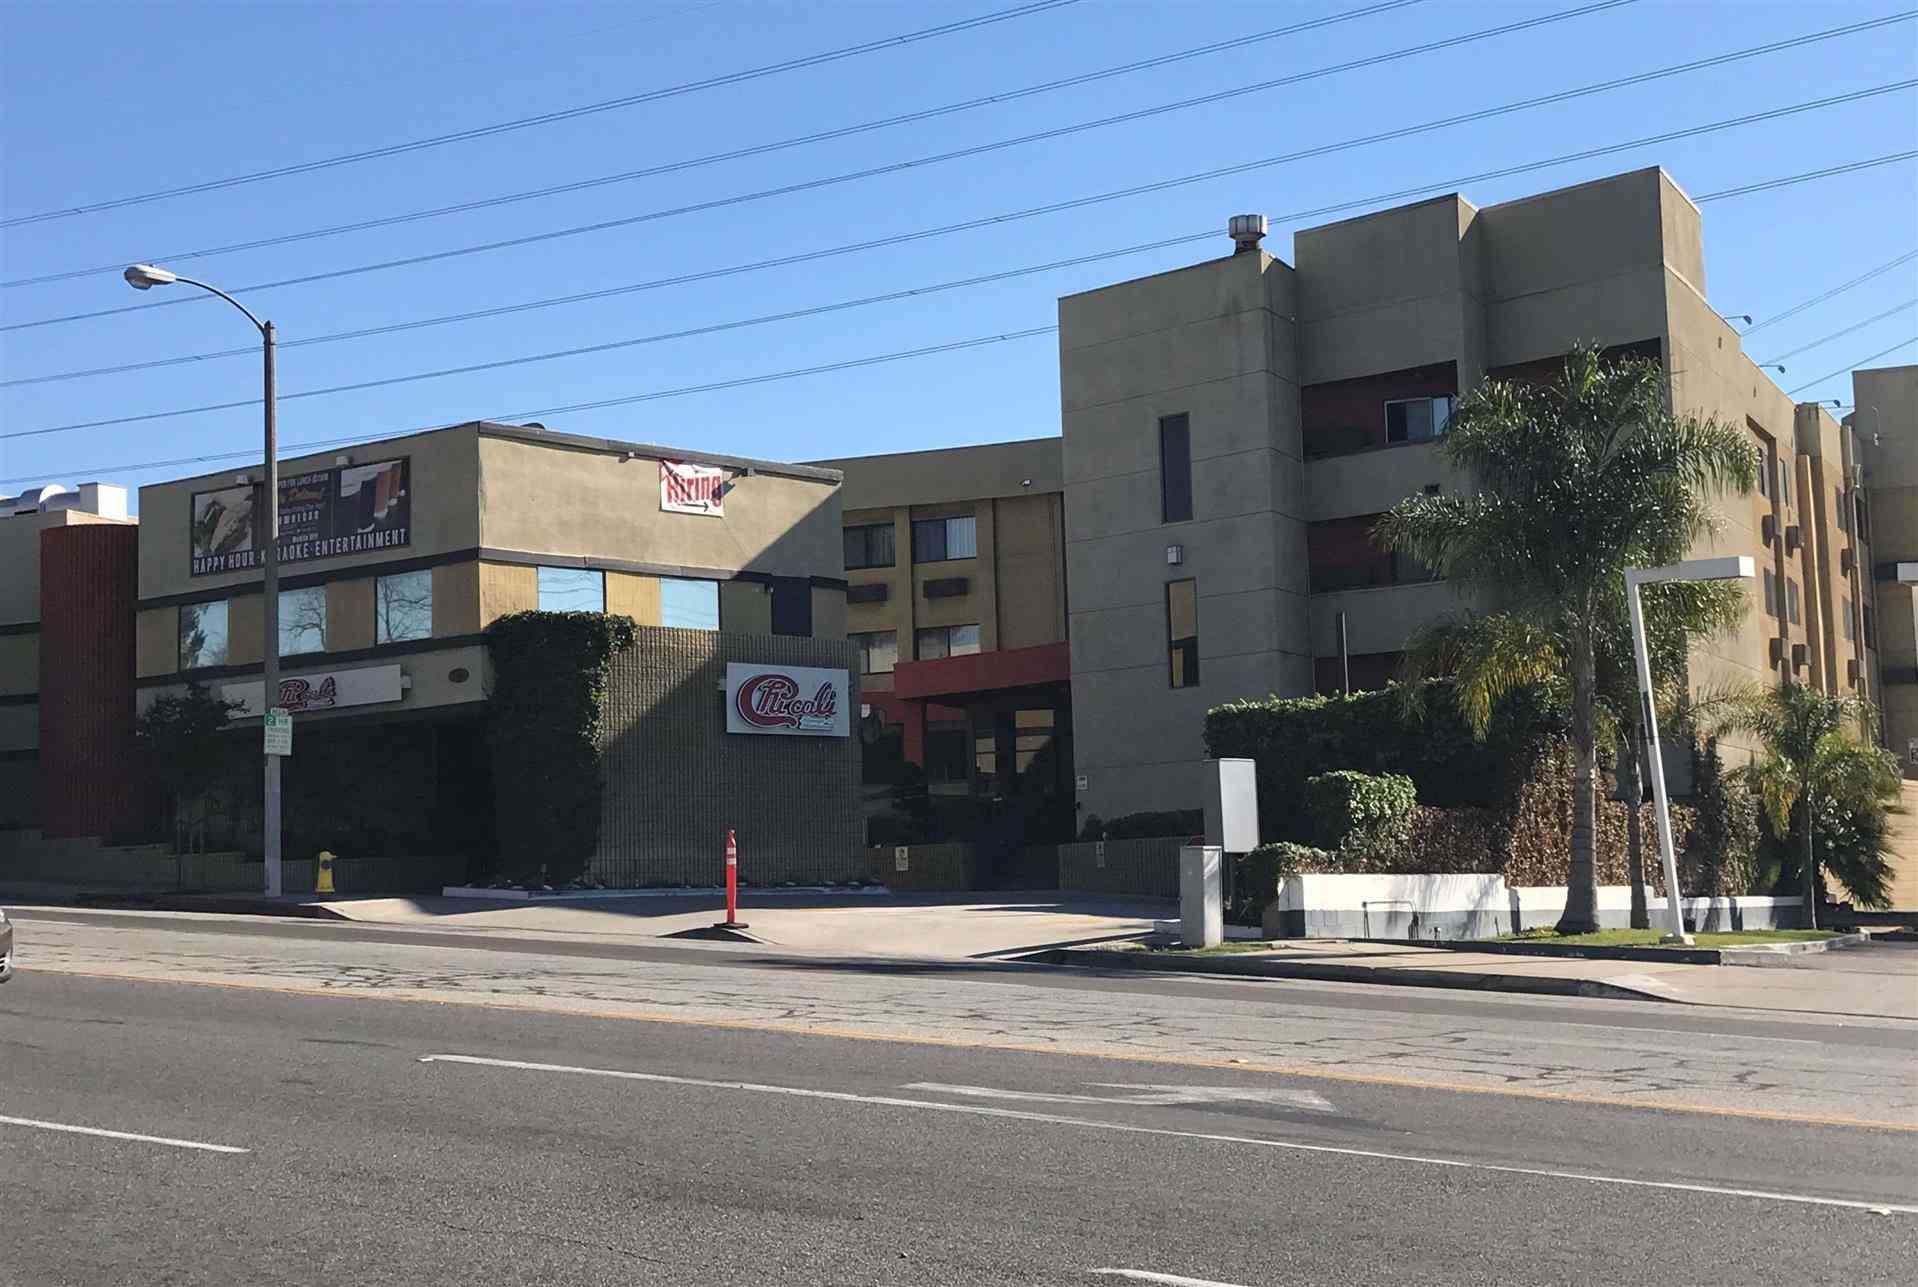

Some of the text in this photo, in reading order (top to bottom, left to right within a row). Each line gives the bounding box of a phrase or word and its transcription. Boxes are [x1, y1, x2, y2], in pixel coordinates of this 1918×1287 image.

[193, 556, 225, 575] HAPPY
[228, 551, 255, 570] HOUR
[260, 542, 310, 565] KRAOKE
[314, 528, 407, 557] ENTERTAINMENT
[736, 673, 837, 728] Chicali
